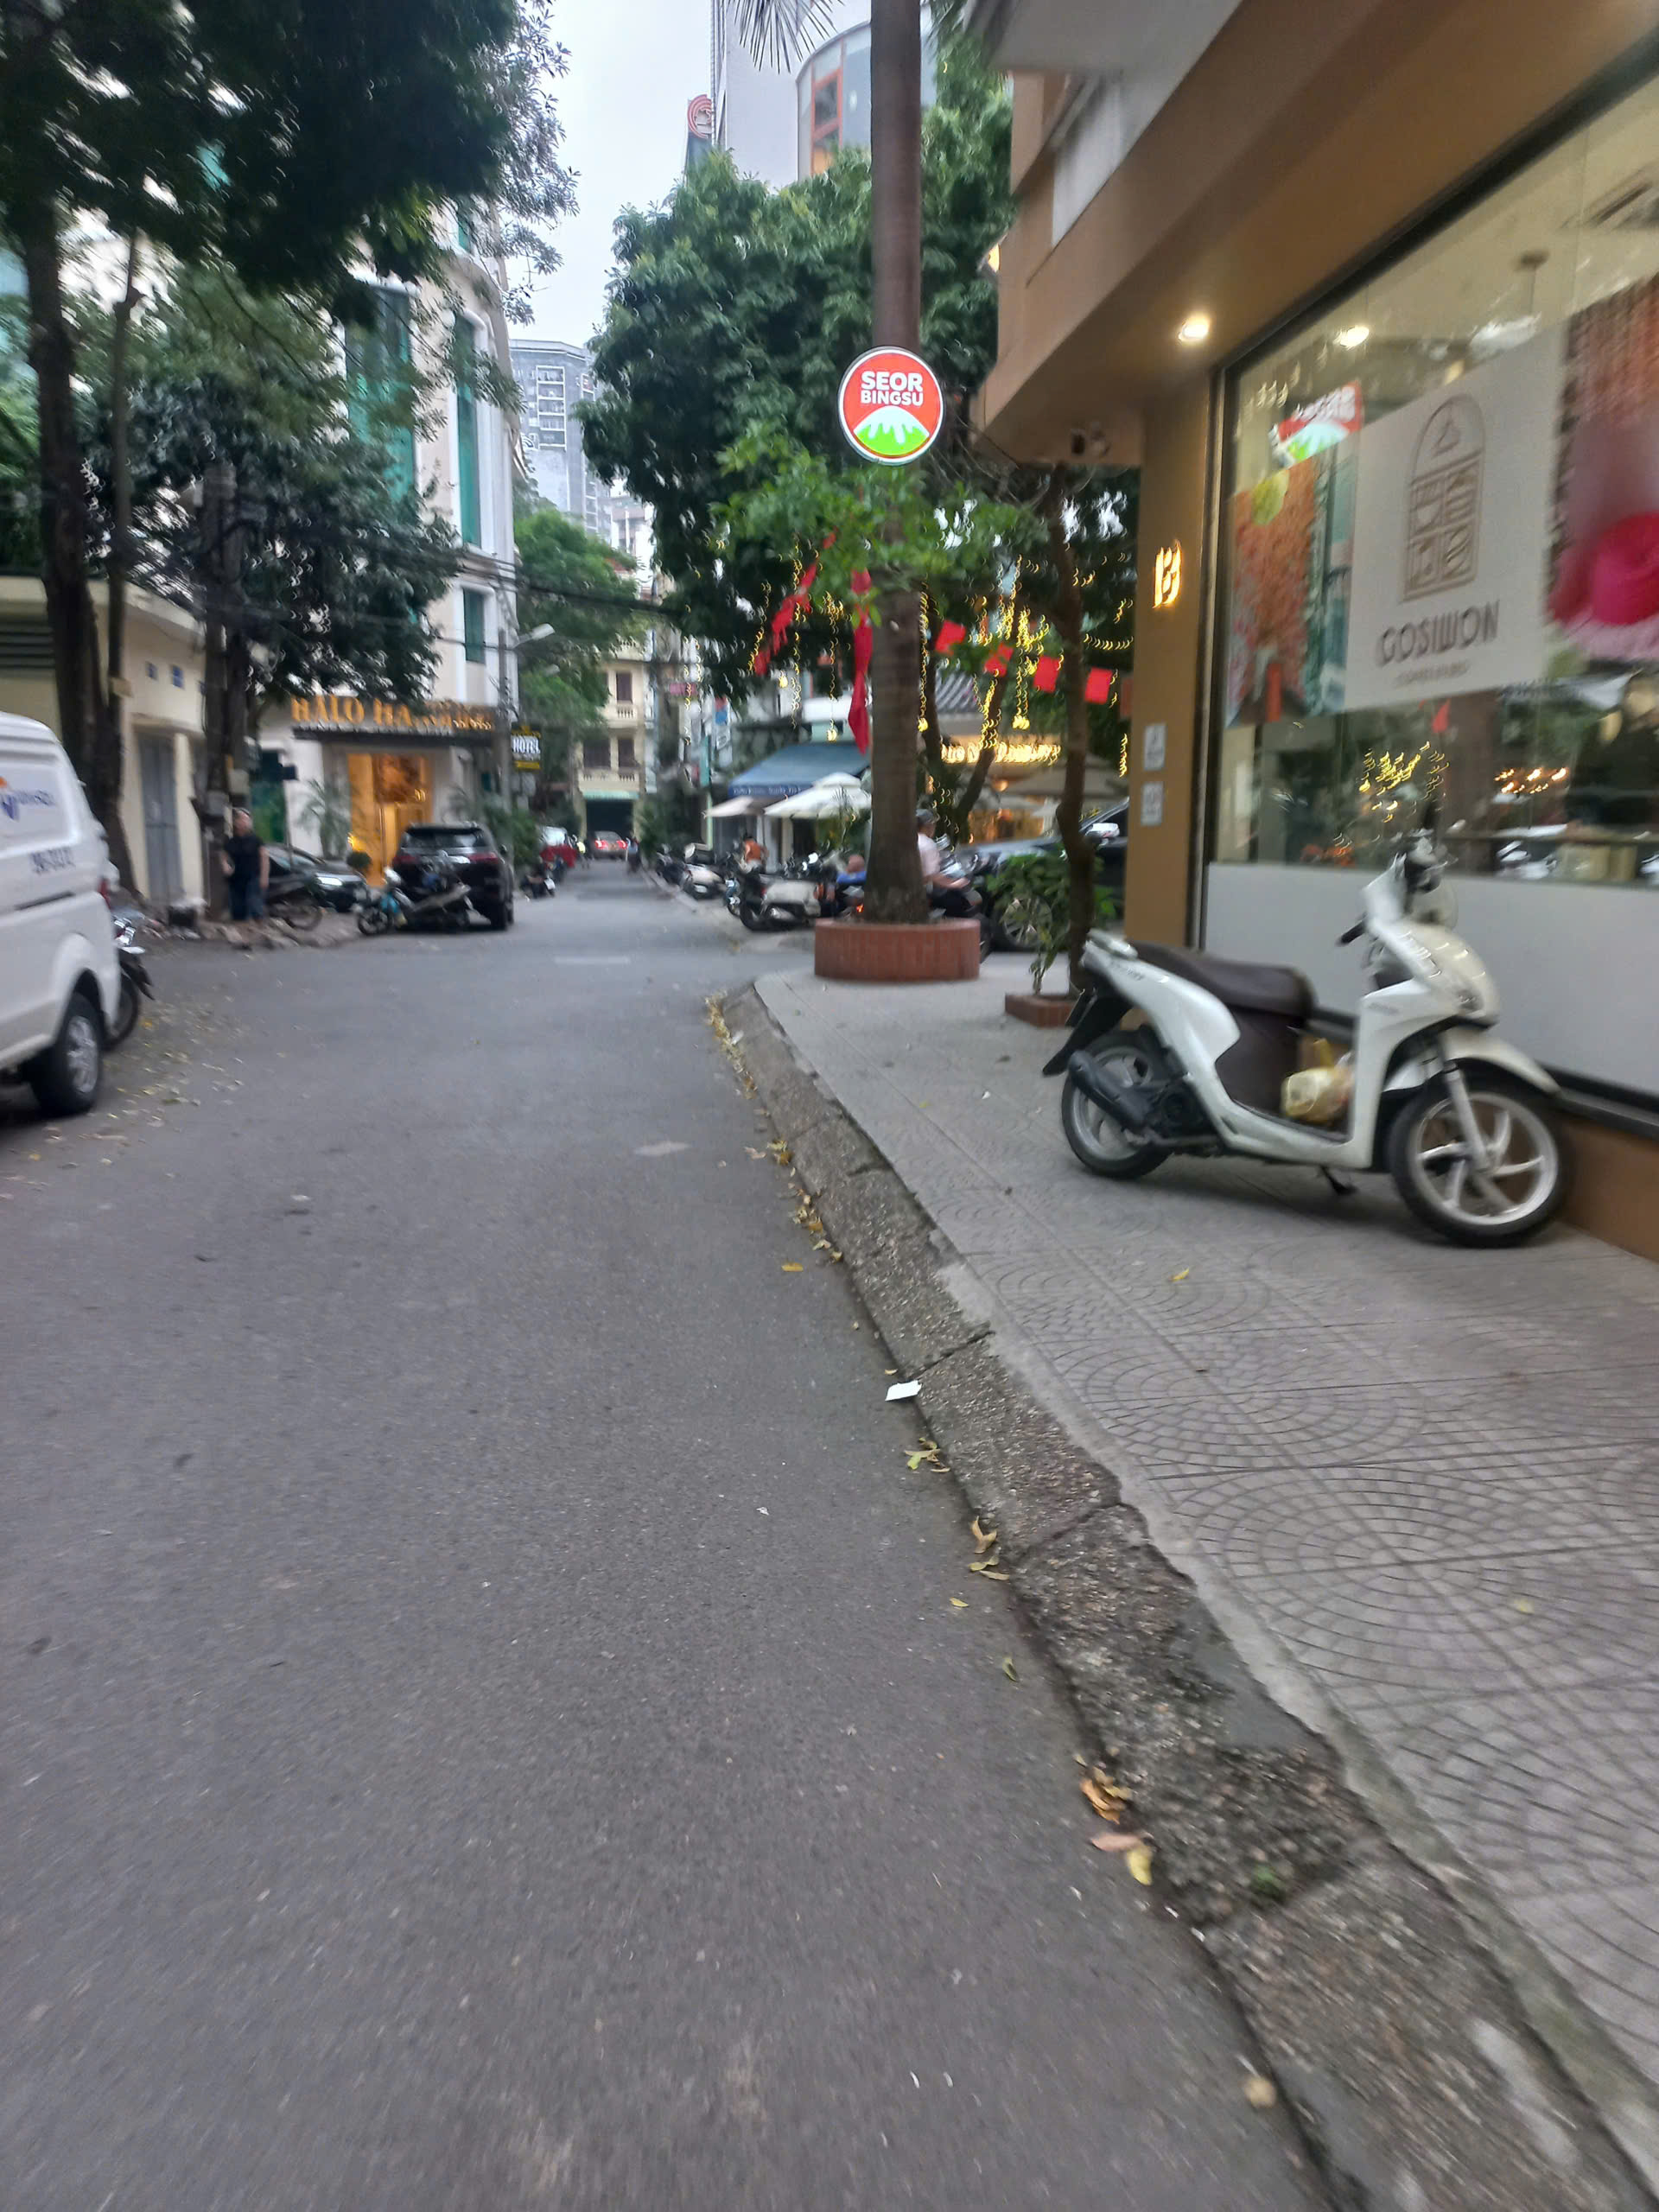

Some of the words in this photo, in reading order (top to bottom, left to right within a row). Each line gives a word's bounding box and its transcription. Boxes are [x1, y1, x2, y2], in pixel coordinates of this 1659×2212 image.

[861, 371, 923, 391] SEOR
[861, 390, 924, 406] BINGSU
[1376, 599, 1500, 667] GOSIWON
[287, 694, 365, 724] HALO
[511, 734, 540, 754] HOTEL
